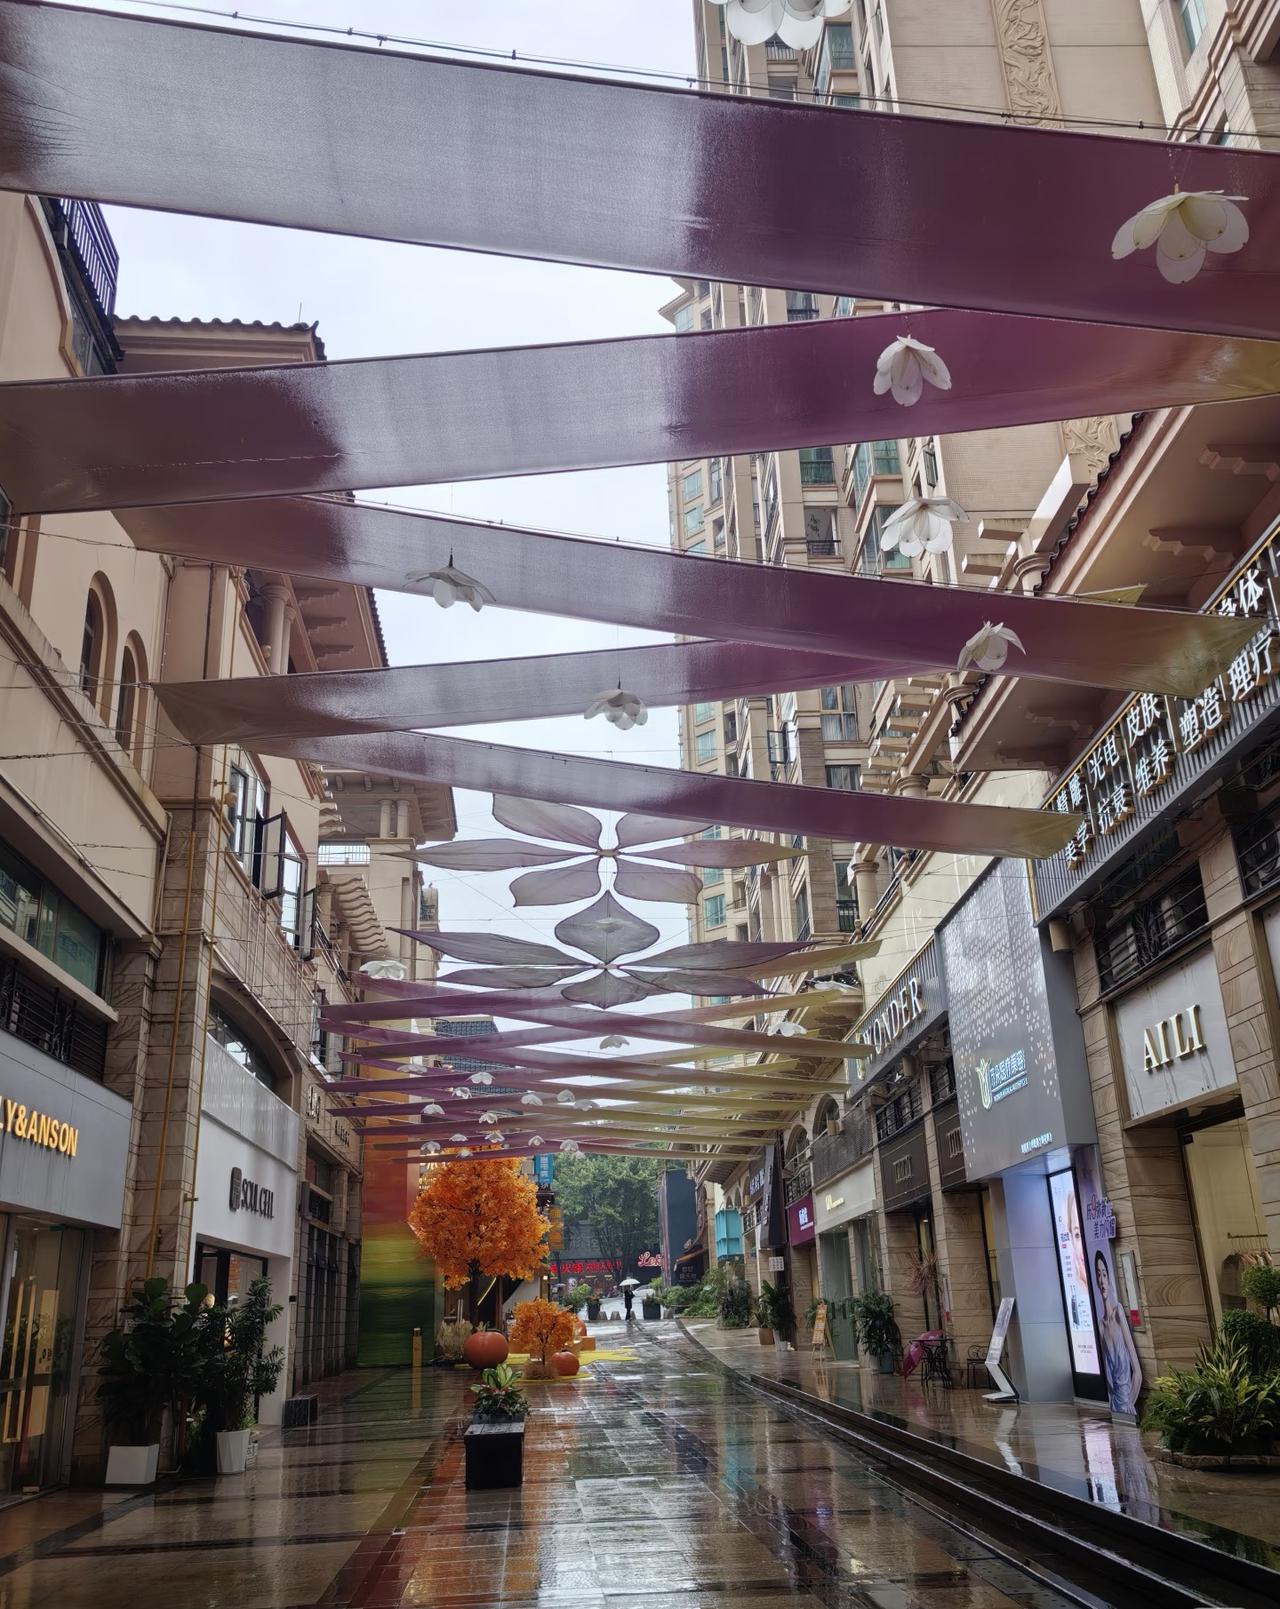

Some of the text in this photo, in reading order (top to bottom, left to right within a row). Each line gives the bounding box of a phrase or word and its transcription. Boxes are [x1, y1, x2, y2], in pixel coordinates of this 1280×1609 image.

[1065, 629, 1272, 870] 美学 抗衰 维养 塑造 理疗
[1089, 734, 1120, 789] 光电
[1126, 693, 1160, 748] 皮肤
[1143, 1004, 1205, 1072] AILI
